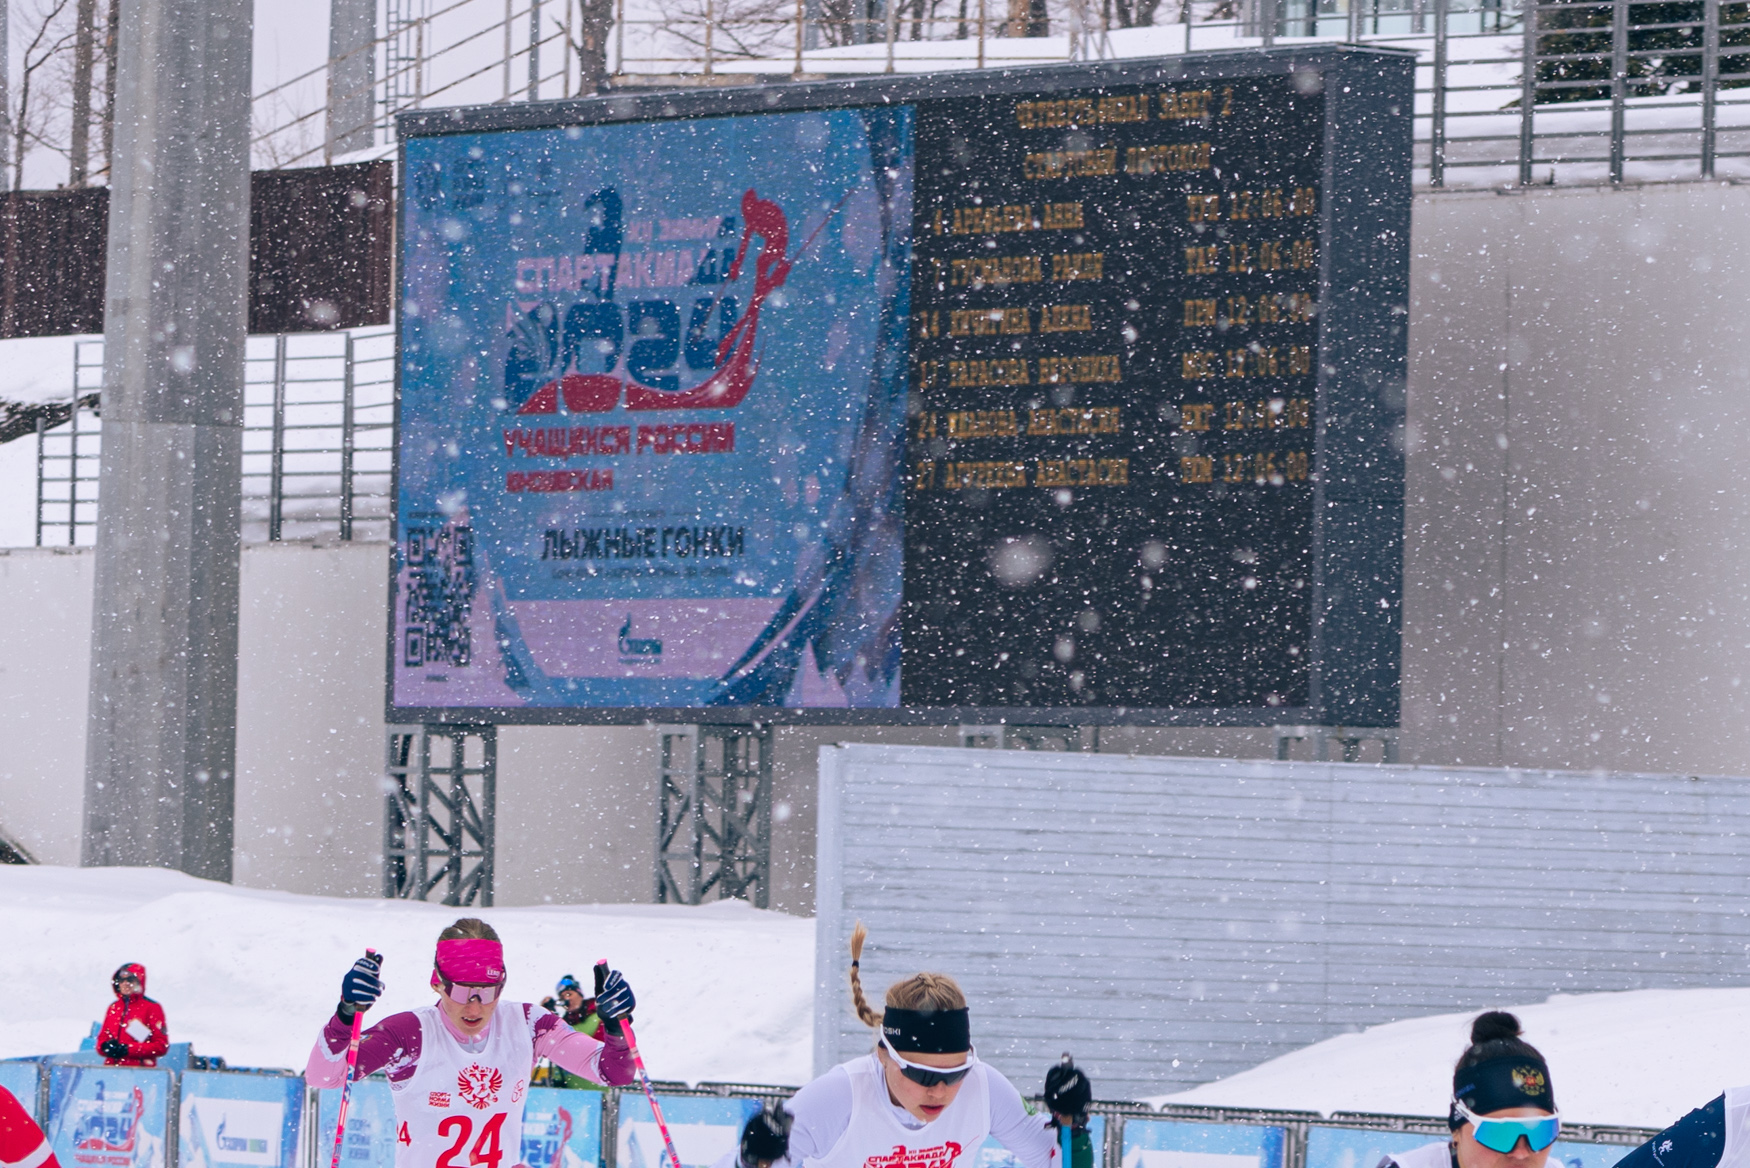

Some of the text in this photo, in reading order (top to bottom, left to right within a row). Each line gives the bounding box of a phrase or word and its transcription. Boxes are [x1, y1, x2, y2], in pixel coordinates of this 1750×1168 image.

[1158, 90, 1213, 120] ЗАБЕГ
[1222, 87, 1233, 116] 2
[1125, 143, 1211, 174] ПРОТОКОЛ
[1042, 202, 1086, 230] АННА
[1230, 187, 1315, 220] 12:06:00
[1228, 240, 1313, 273] 12:06:00
[919, 309, 940, 339] 14
[1227, 292, 1312, 325] 12:06:00
[948, 357, 1031, 388] ТАРАСОВА
[1038, 354, 1122, 385] ВЕРОНИКА
[1226, 345, 1311, 378] 12:06:00
[637, 422, 736, 455] РОССИИ
[917, 410, 937, 439] 24
[1027, 406, 1120, 437] АНАСТАСИЯ
[915, 461, 936, 491] 27
[1035, 457, 1129, 488] АНАСТАСИЯ
[1223, 451, 1308, 482] 12:06:00
[541, 526, 746, 561] ЛЫЖНЫЕ ГОНКИ
[868, 1151, 946, 1164] СПАРТАКИАДА
